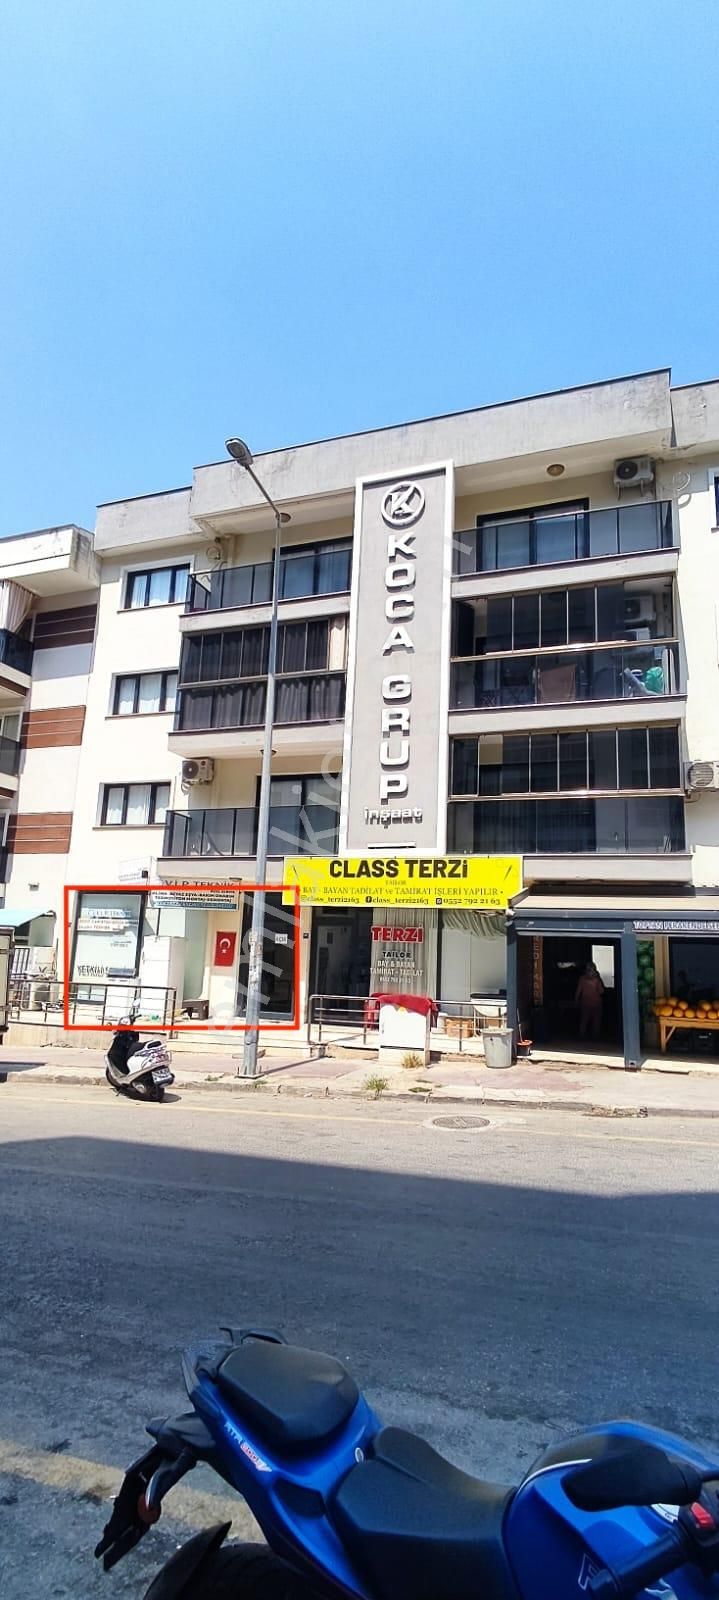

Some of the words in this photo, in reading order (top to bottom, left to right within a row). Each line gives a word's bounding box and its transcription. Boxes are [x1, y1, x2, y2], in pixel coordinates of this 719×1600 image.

[382, 532, 416, 654] KOCA
[380, 674, 412, 804] GRUP
[330, 860, 399, 878] CLASS
[323, 886, 350, 894] BAYAN
[371, 922, 424, 944] TERZİ
